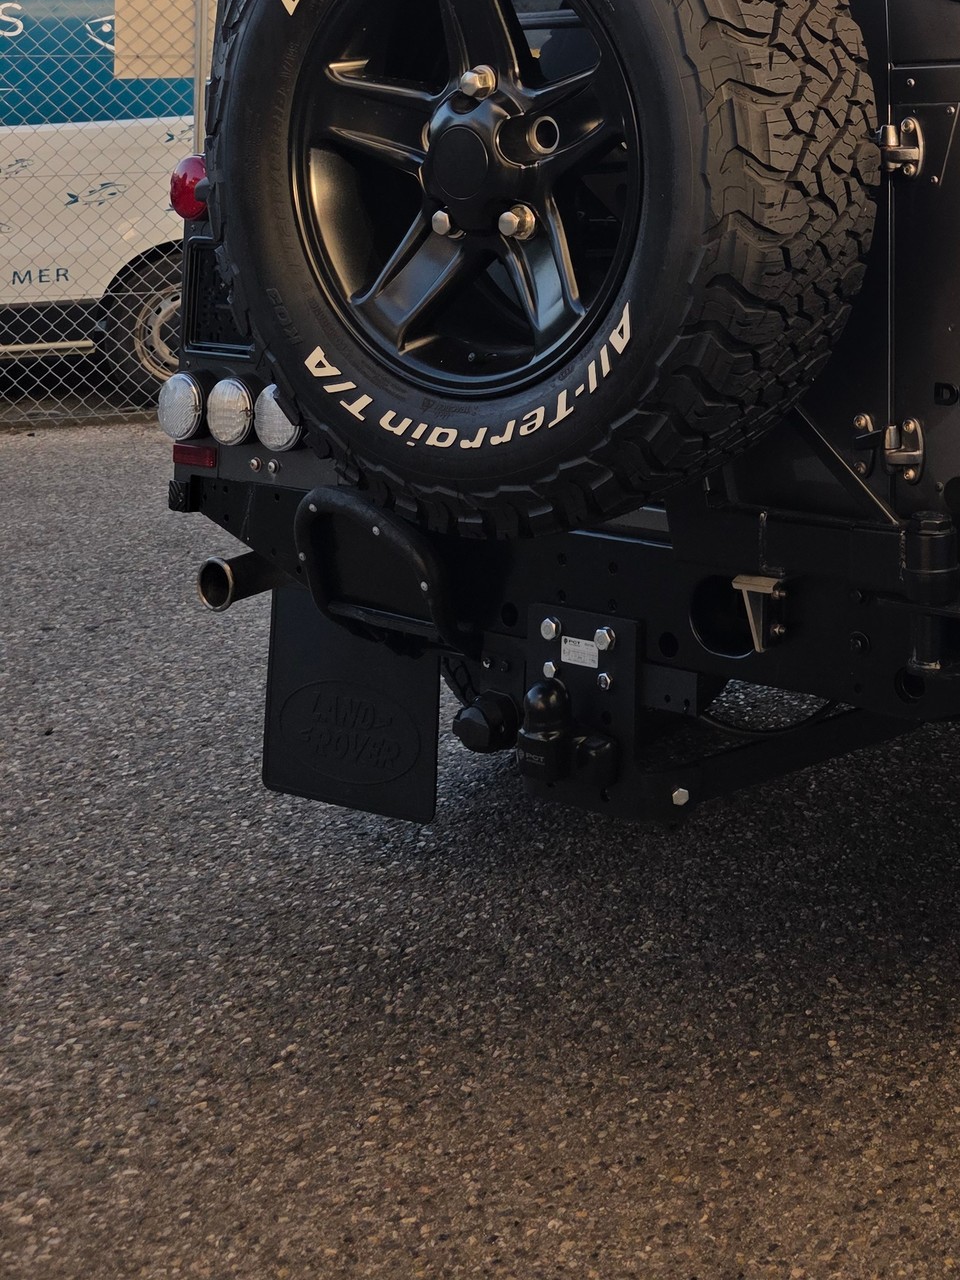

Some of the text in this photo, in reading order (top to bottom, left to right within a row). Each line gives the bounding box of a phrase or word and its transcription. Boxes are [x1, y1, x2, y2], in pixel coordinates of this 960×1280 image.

[12, 267, 69, 285] MER
[304, 345, 373, 421] T/A
[379, 301, 631, 449] All-Terrain
